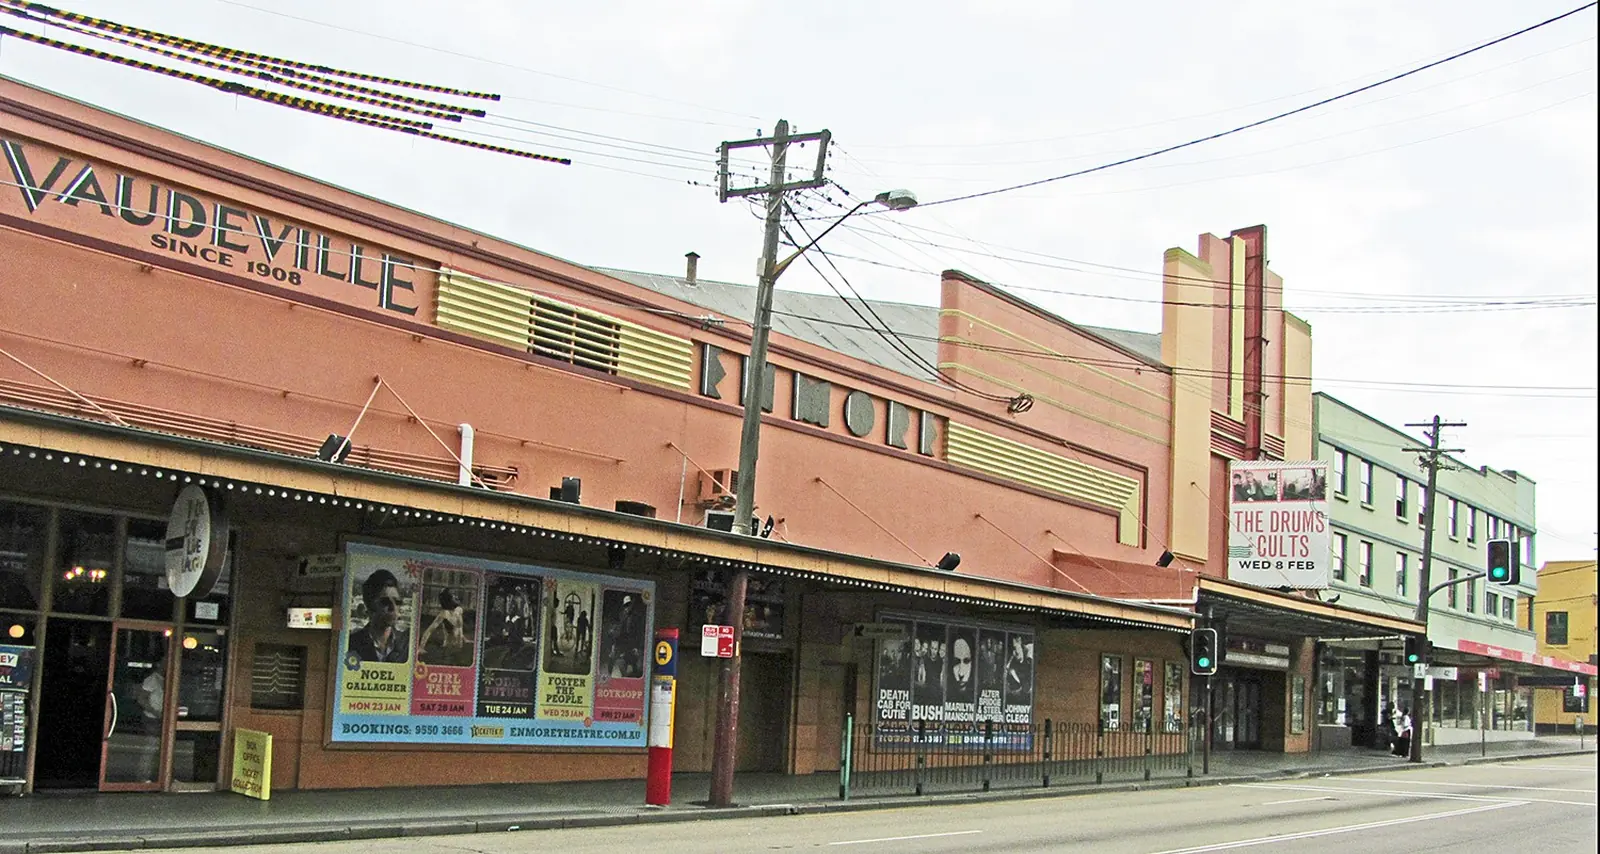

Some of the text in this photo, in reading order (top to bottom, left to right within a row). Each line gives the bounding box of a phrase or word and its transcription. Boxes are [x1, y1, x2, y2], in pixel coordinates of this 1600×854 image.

[1, 139, 419, 316] VAUDEVILLE
[150, 234, 303, 286] SINCE 1908
[1234, 510, 1325, 533] THE DRUMS
[1257, 535, 1309, 558] CULTS
[1239, 560, 1315, 570] WED 8 FEB
[360, 669, 395, 681] NOEL
[428, 672, 461, 684] GIRL
[548, 676, 586, 687] FOSTER
[346, 682, 407, 692] GALLAGHER
[426, 683, 462, 695] TALK
[555, 686, 575, 695] THE
[484, 687, 529, 698] FUTURE
[880, 689, 909, 700] DEATH
[981, 689, 1000, 698] ALTER
[546, 694, 583, 705] PEOPLE
[877, 699, 911, 710] CAB FOR
[979, 697, 1001, 707] BRIDGE
[348, 702, 401, 711] MON 23 JAN
[420, 703, 465, 712] SAT 28 JAN
[485, 705, 501, 714] TUE
[501, 706, 512, 714] 24
[945, 702, 975, 712] MARILYN
[977, 706, 1002, 714] & STEEL
[1004, 704, 1031, 714] JOHNNY
[543, 709, 560, 717] WED
[570, 710, 584, 718] JAN
[622, 711, 635, 719] JAN
[882, 709, 906, 719] CUTIE
[912, 704, 944, 721] BUSH
[945, 711, 974, 722] MANSON
[975, 713, 1004, 723] PANTHER
[1005, 713, 1029, 723] CLEGG
[342, 723, 412, 735] BOOKINGS:
[415, 725, 439, 735] 9550
[510, 727, 641, 740] ENMORETHEATRE.COM.AU
